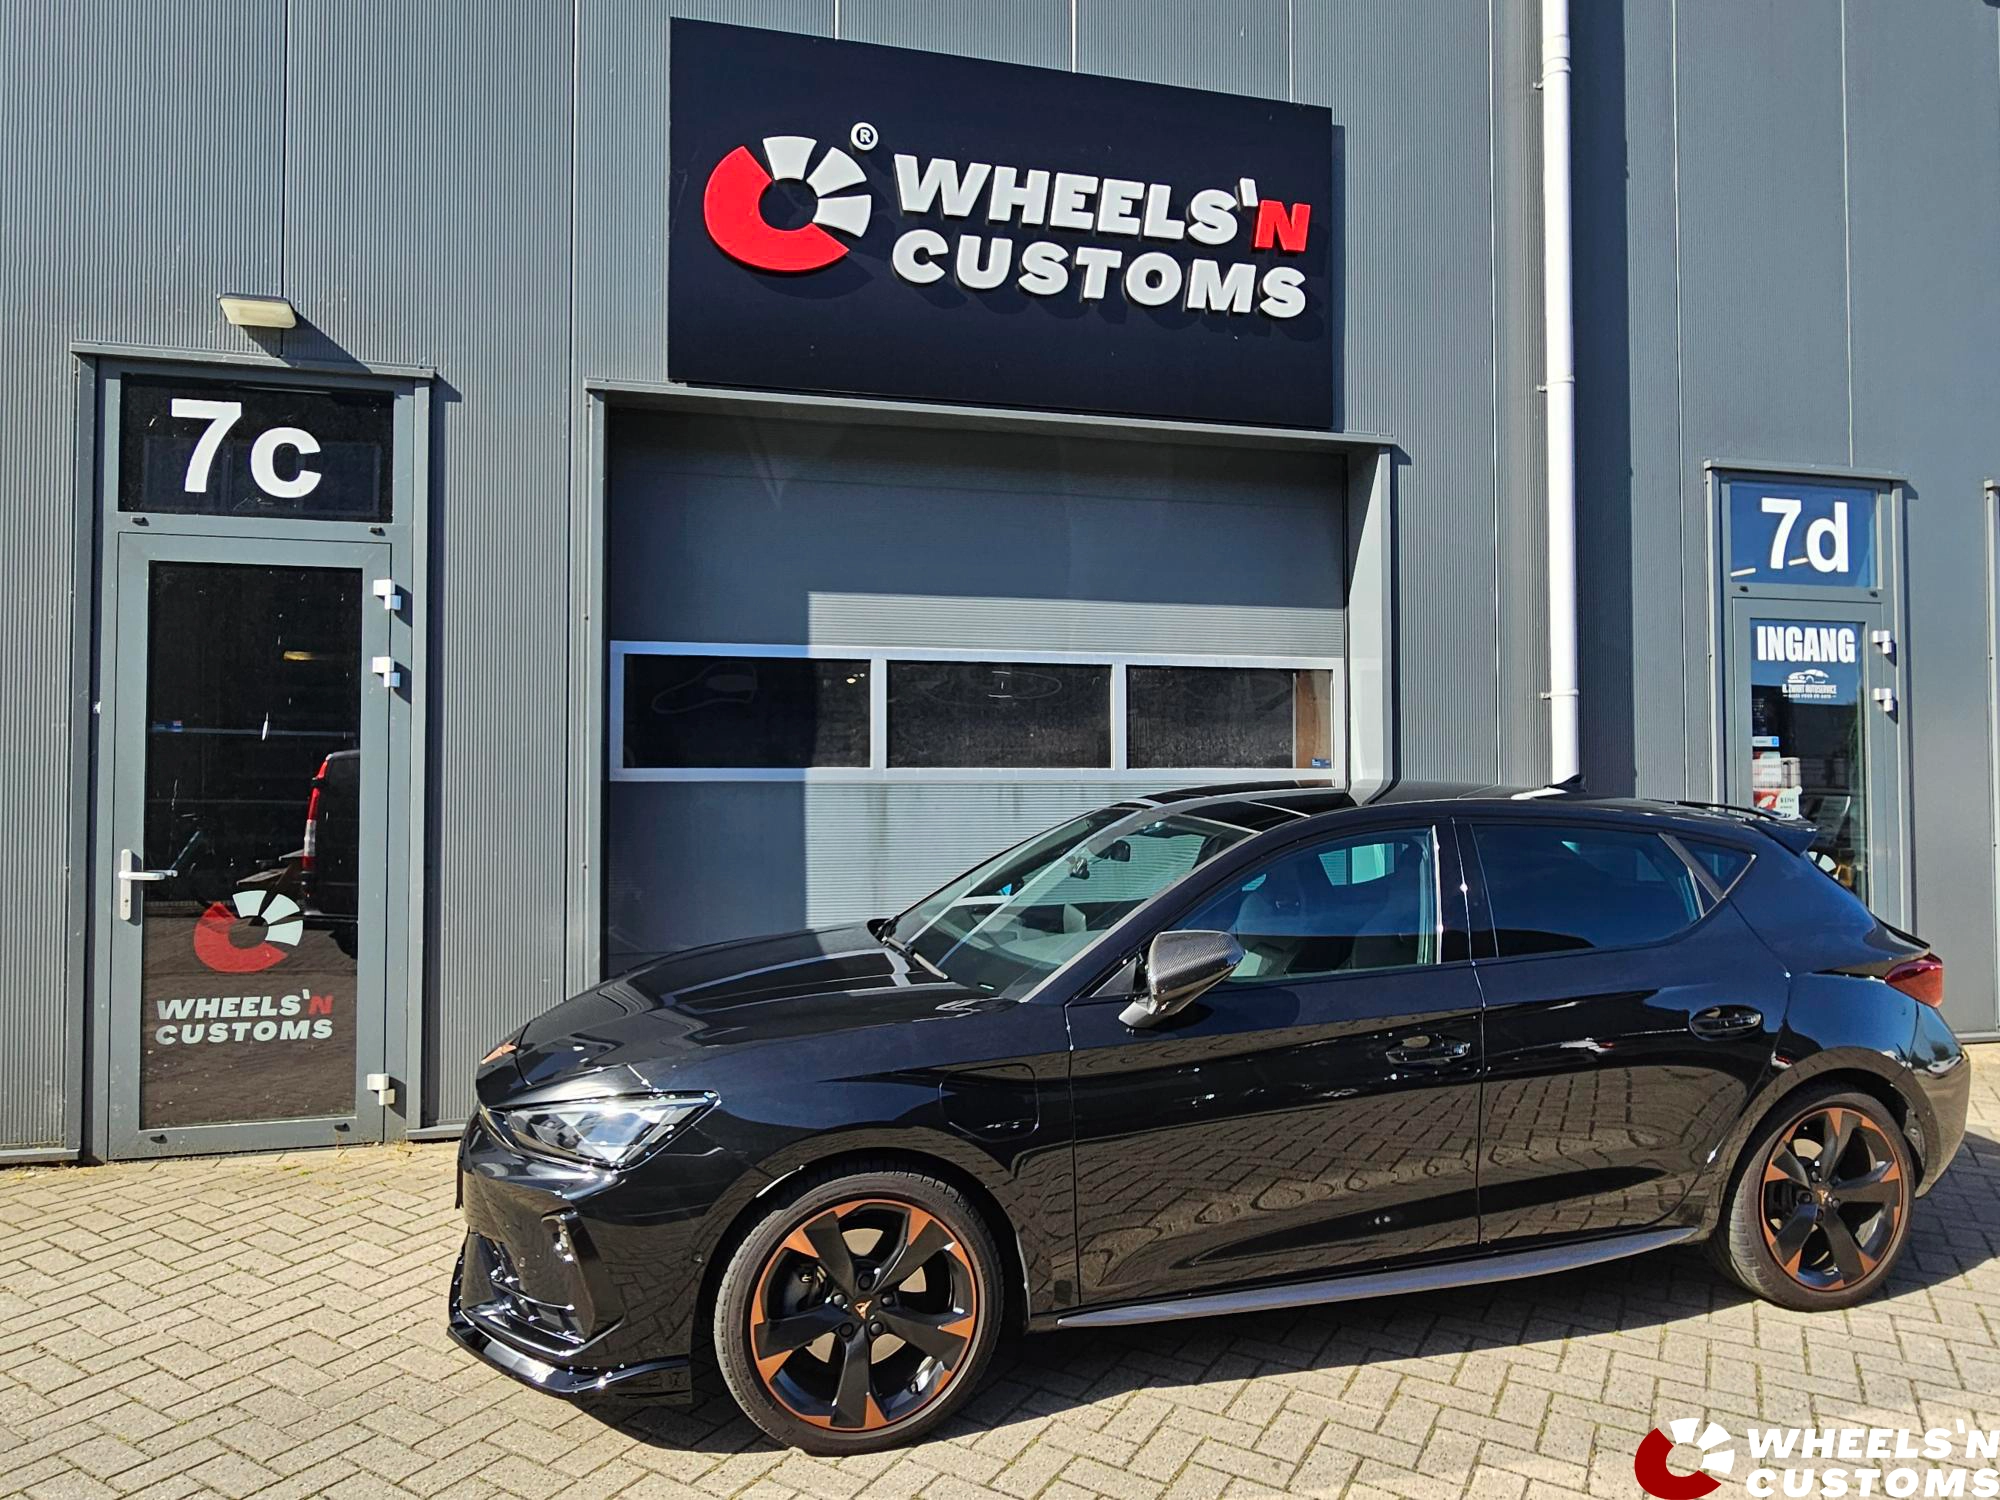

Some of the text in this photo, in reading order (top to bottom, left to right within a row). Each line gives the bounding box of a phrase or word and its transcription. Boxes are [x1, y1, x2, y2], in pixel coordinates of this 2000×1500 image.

[892, 228, 1307, 319] CUSTOMS
[171, 398, 322, 499] 7c
[1761, 497, 1849, 573] 7d
[1756, 625, 1856, 664] INGANG
[155, 1018, 333, 1046] CUSTOMS
